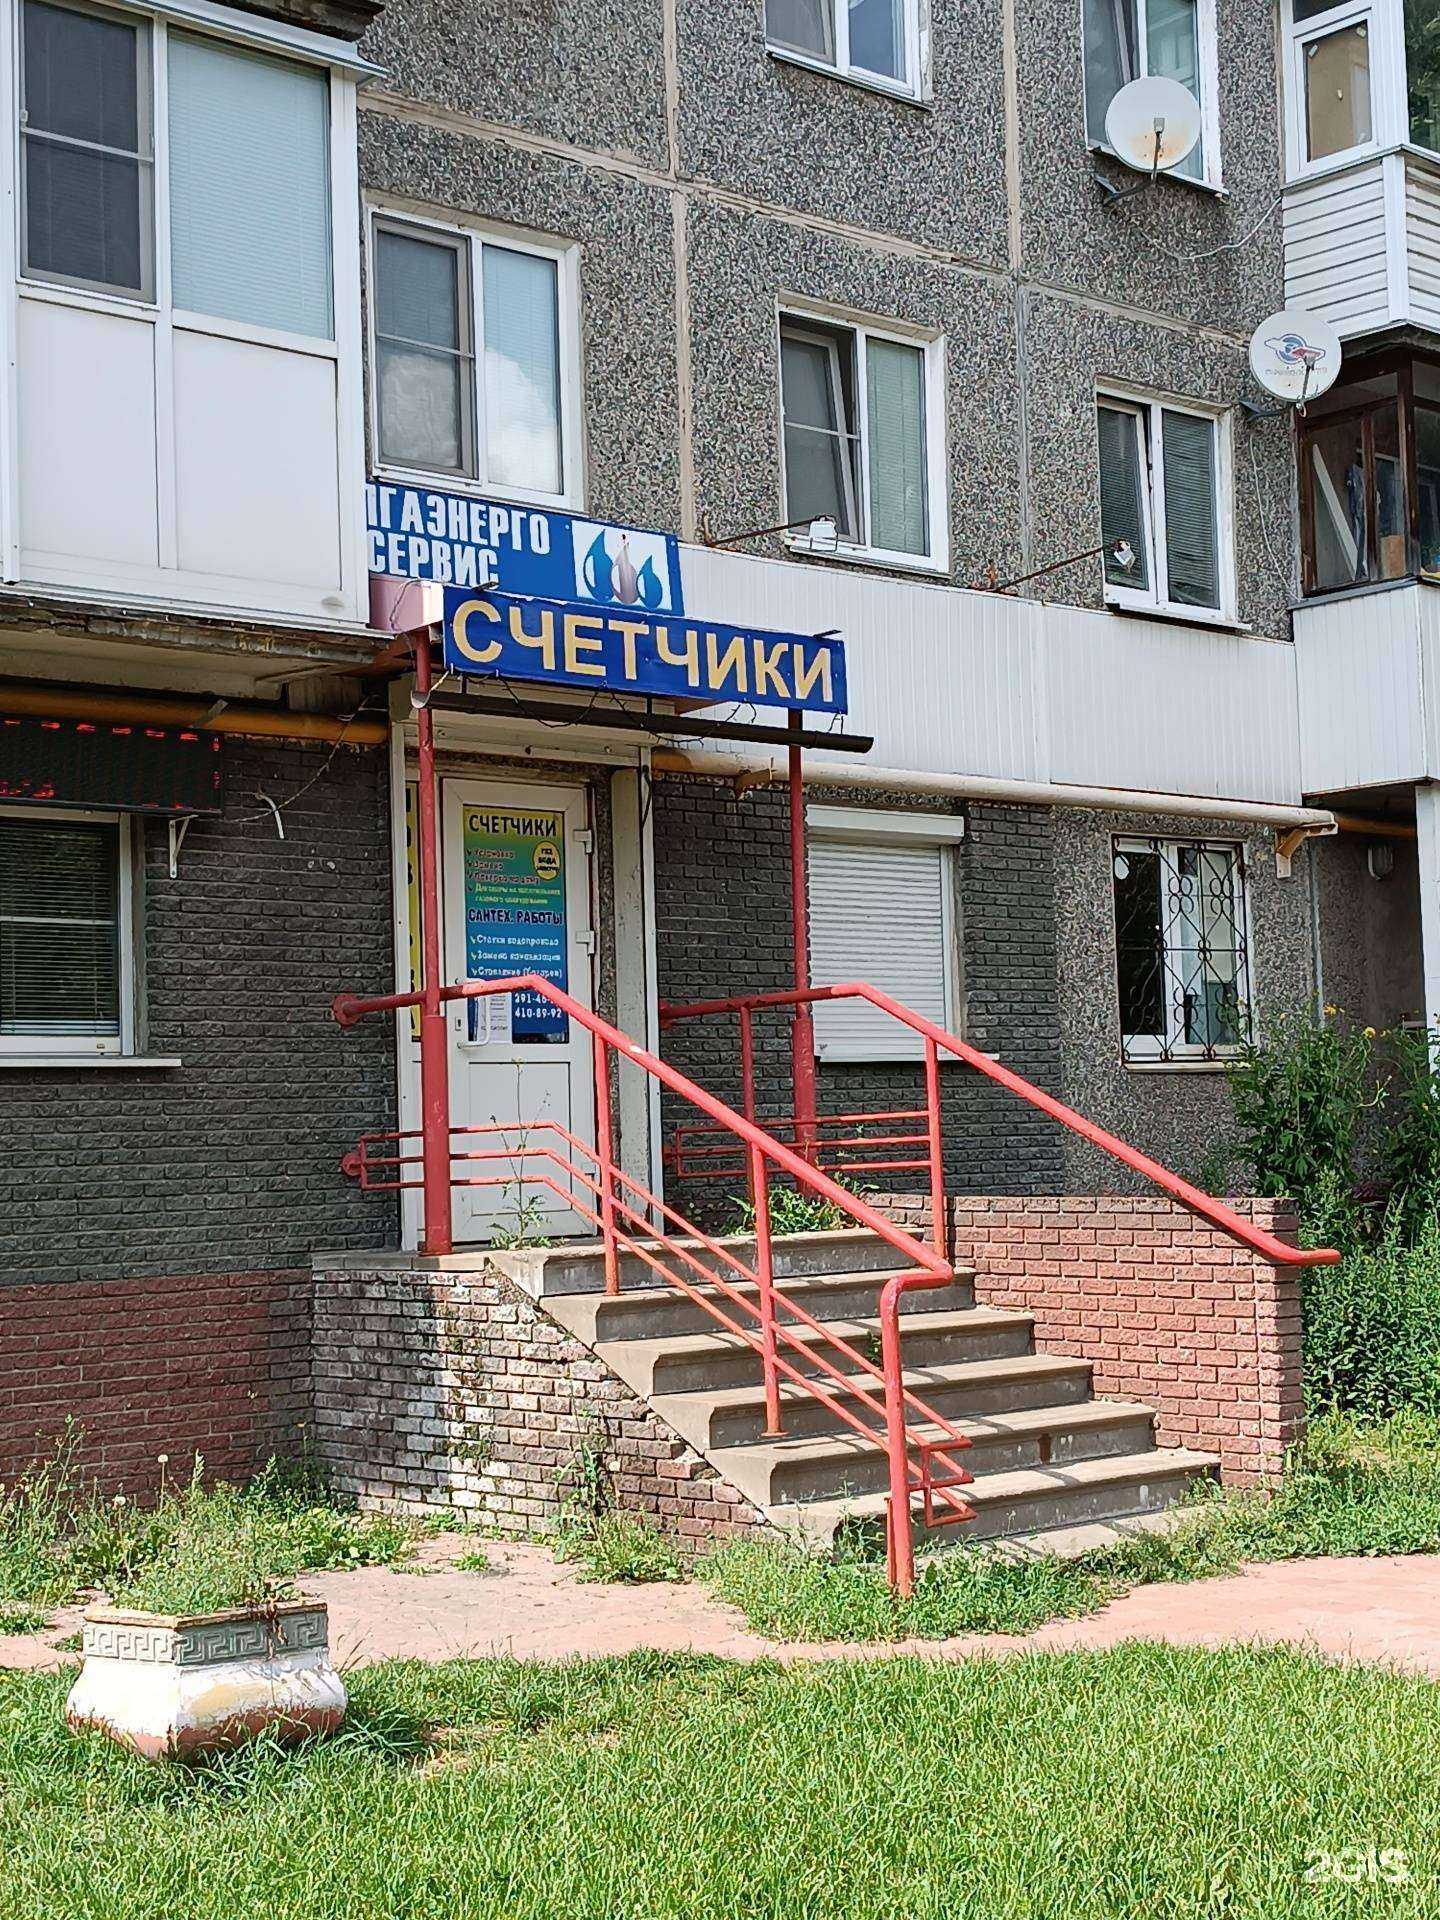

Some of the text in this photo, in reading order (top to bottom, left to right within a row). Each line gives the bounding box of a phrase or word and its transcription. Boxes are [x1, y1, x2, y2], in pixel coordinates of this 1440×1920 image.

[367, 529, 499, 590] СЕРВИС
[452, 599, 832, 702] СЧЕТЧИКИ
[468, 814, 556, 837] СЧЕТЧИКИ
[468, 908, 563, 925] САНТЕХ. РАБОТЫ
[514, 1006, 562, 1018] 410-89-92
